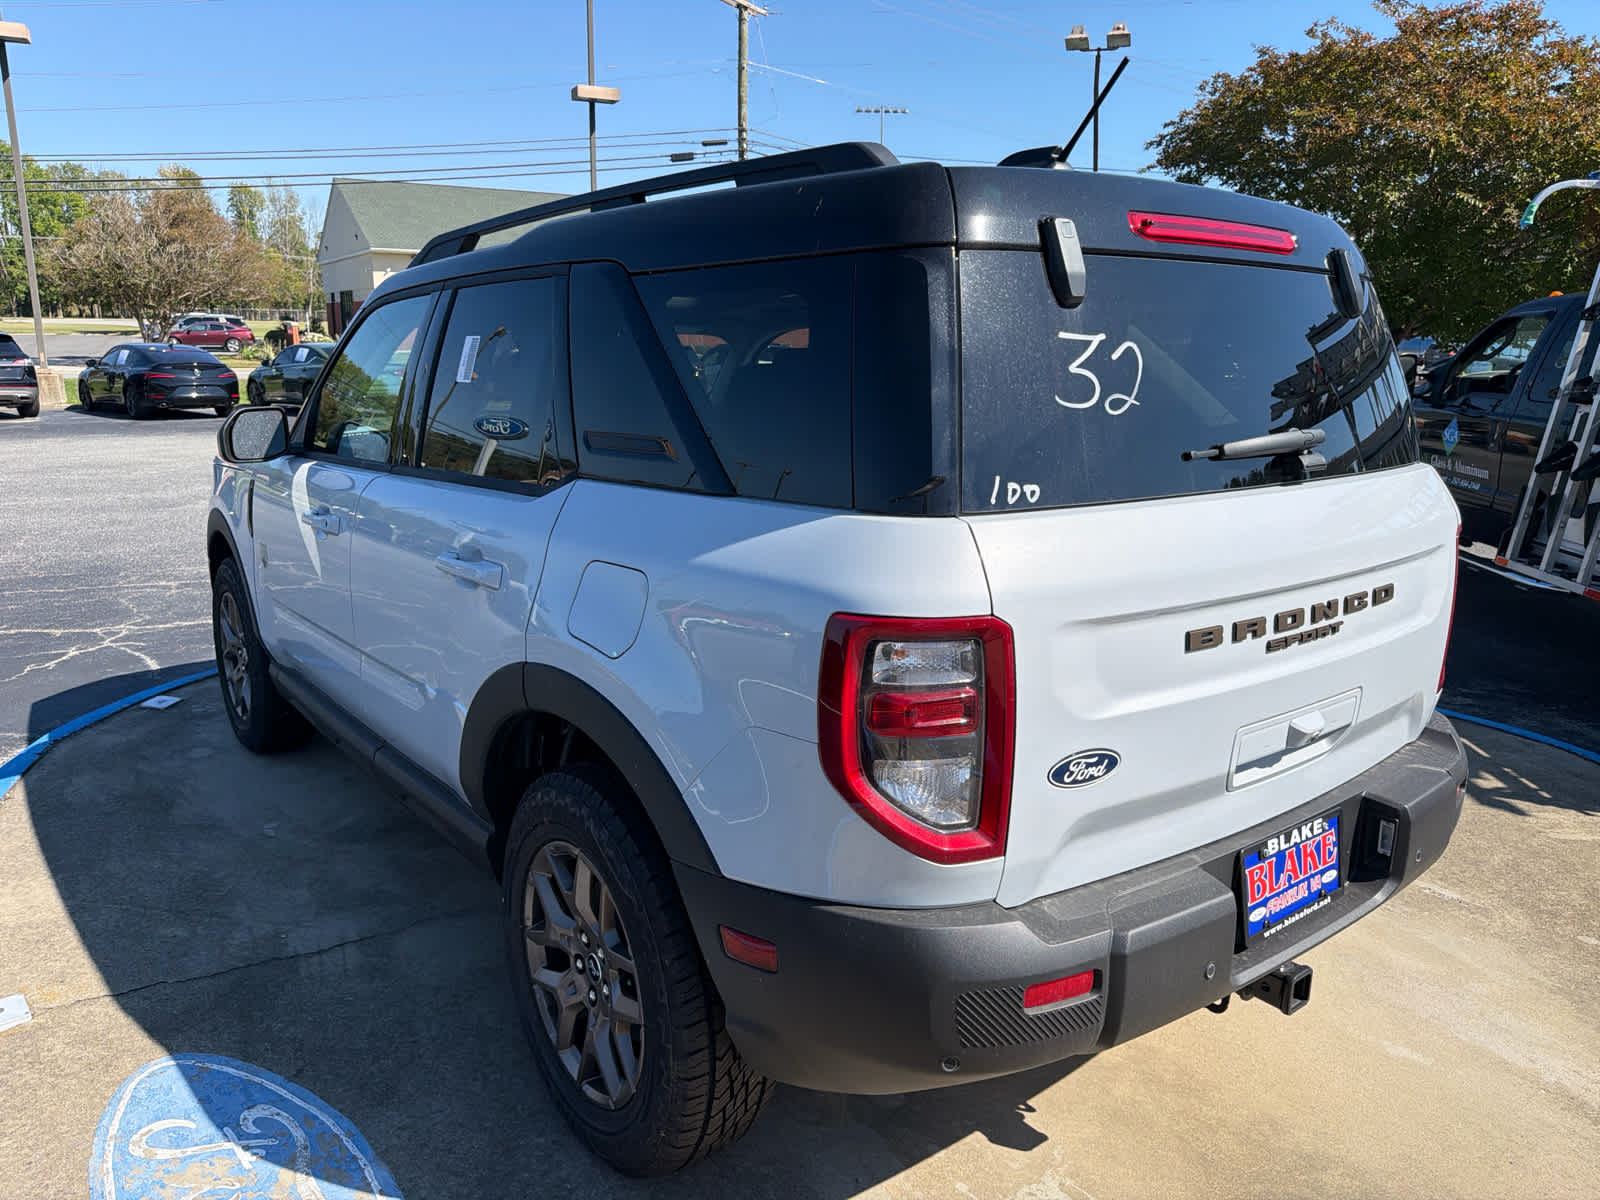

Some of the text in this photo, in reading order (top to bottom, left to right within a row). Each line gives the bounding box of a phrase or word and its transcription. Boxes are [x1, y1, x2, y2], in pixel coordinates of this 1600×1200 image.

[1055, 331, 1143, 415] 32
[990, 475, 1040, 504] 100
[1184, 583, 1394, 654] BRONCO
[1265, 621, 1344, 654] SPORT
[1064, 757, 1108, 783] Ford
[1267, 818, 1323, 856] BLAKE
[1245, 828, 1338, 907] BLAKE
[1263, 896, 1331, 938] www.blakeford.net
